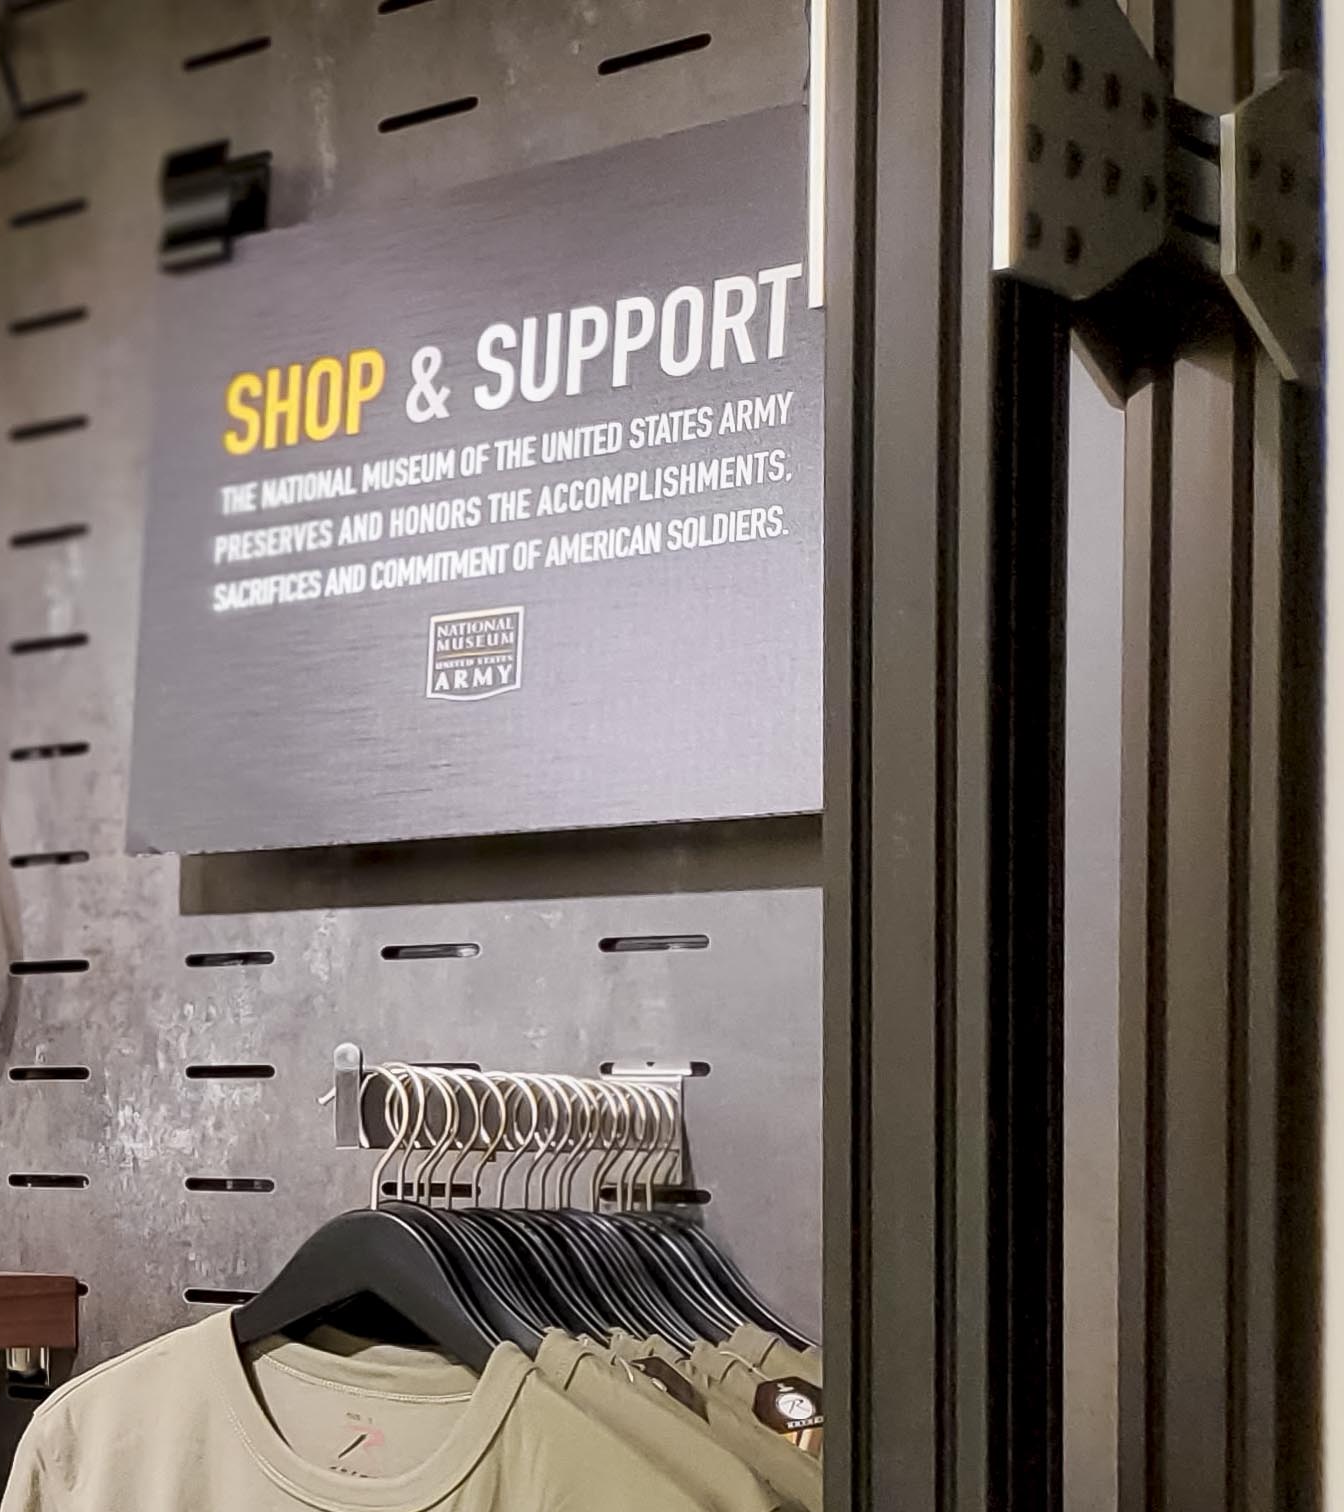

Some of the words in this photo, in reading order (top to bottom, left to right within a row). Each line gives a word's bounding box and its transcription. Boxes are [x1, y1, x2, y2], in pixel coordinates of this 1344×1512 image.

[222, 347, 386, 455] SHOP
[405, 346, 451, 423] &
[474, 263, 802, 410] SUPPORT
[213, 519, 334, 565] PRESERVES
[337, 511, 383, 546] AND
[389, 496, 482, 538] HONORS
[487, 488, 532, 524] THE
[536, 449, 792, 517] ACCOMPLISHMENTS,
[221, 482, 258, 515] THE
[261, 466, 357, 509] NATIONAL
[362, 448, 455, 493] MUSEUM
[460, 442, 491, 476] OF
[494, 436, 537, 471] THE
[541, 422, 623, 464] UNITED
[629, 406, 714, 449] STATES
[718, 391, 794, 434] ARMY
[212, 570, 322, 613] SACRIFICES
[324, 563, 366, 597] AND
[370, 543, 510, 590] COMMITMENT
[512, 539, 543, 572] OF
[544, 522, 662, 568] AMERICAN
[667, 505, 789, 551] SOLDIERS.
[434, 664, 512, 691] ARMY
[436, 632, 514, 652] MUSEUM
[437, 617, 514, 638] NATIONAL
